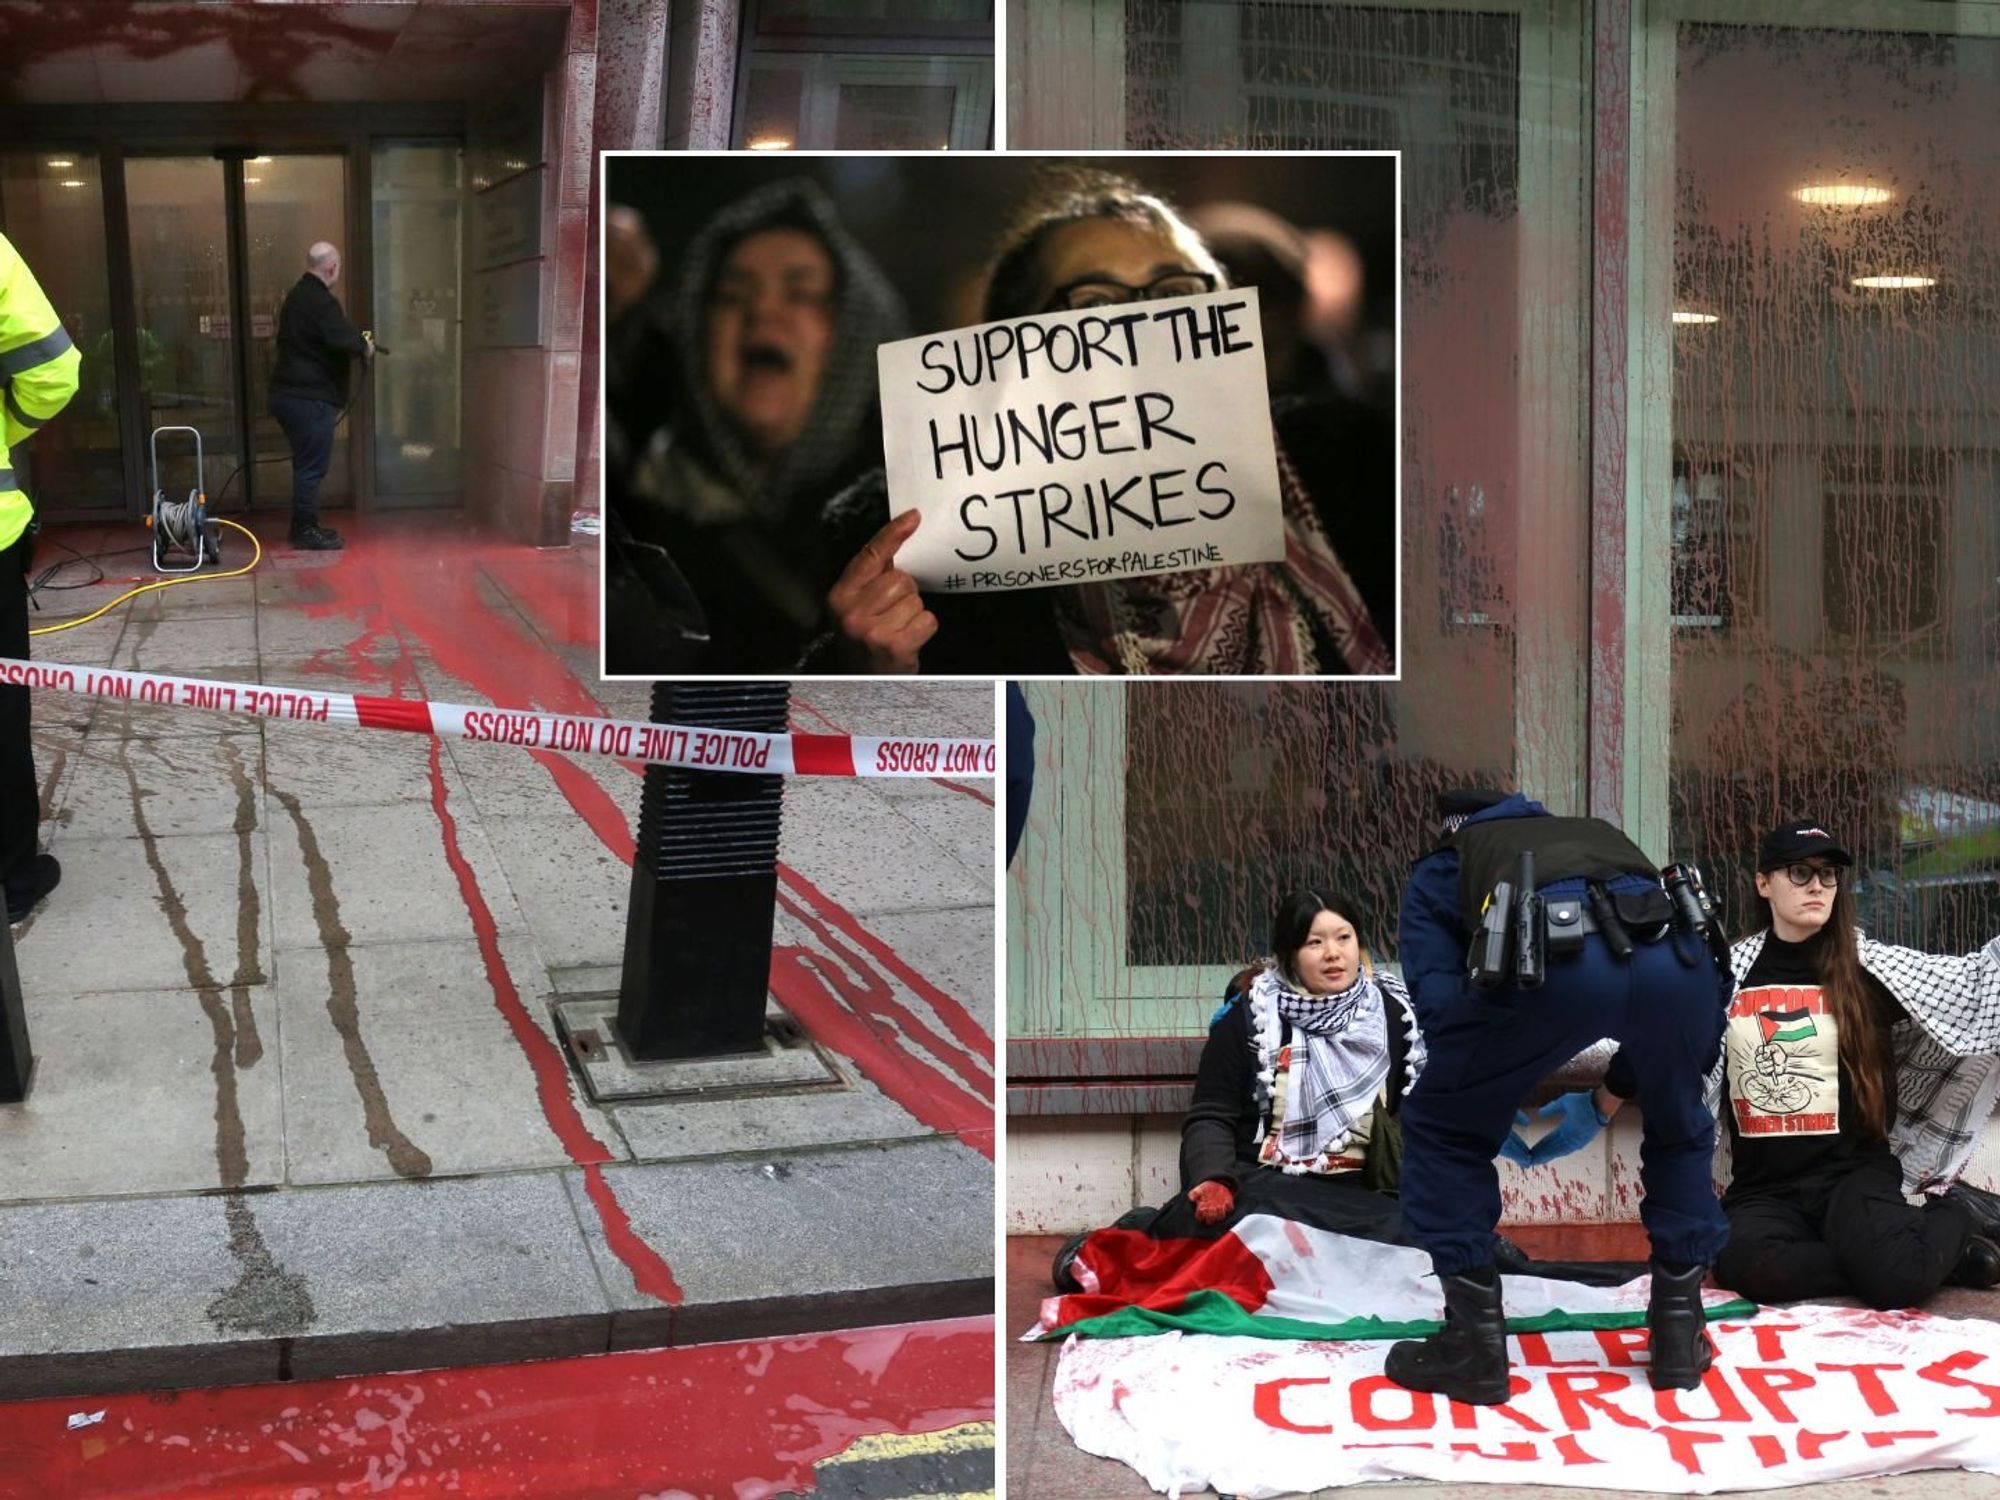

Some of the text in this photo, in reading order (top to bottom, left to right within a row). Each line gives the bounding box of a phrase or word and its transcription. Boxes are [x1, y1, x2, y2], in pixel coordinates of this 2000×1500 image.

[917, 301, 1254, 394] SUPPORT THE
[929, 392, 1196, 480] HUNGER
[955, 461, 1236, 562] STRIKES
[462, 710, 771, 769] POLICE LINE DO NOT CROSS
[876, 741, 940, 772] CROSS
[943, 743, 982, 773] NOT
[1253, 1350, 2000, 1434] CORRUPTS
